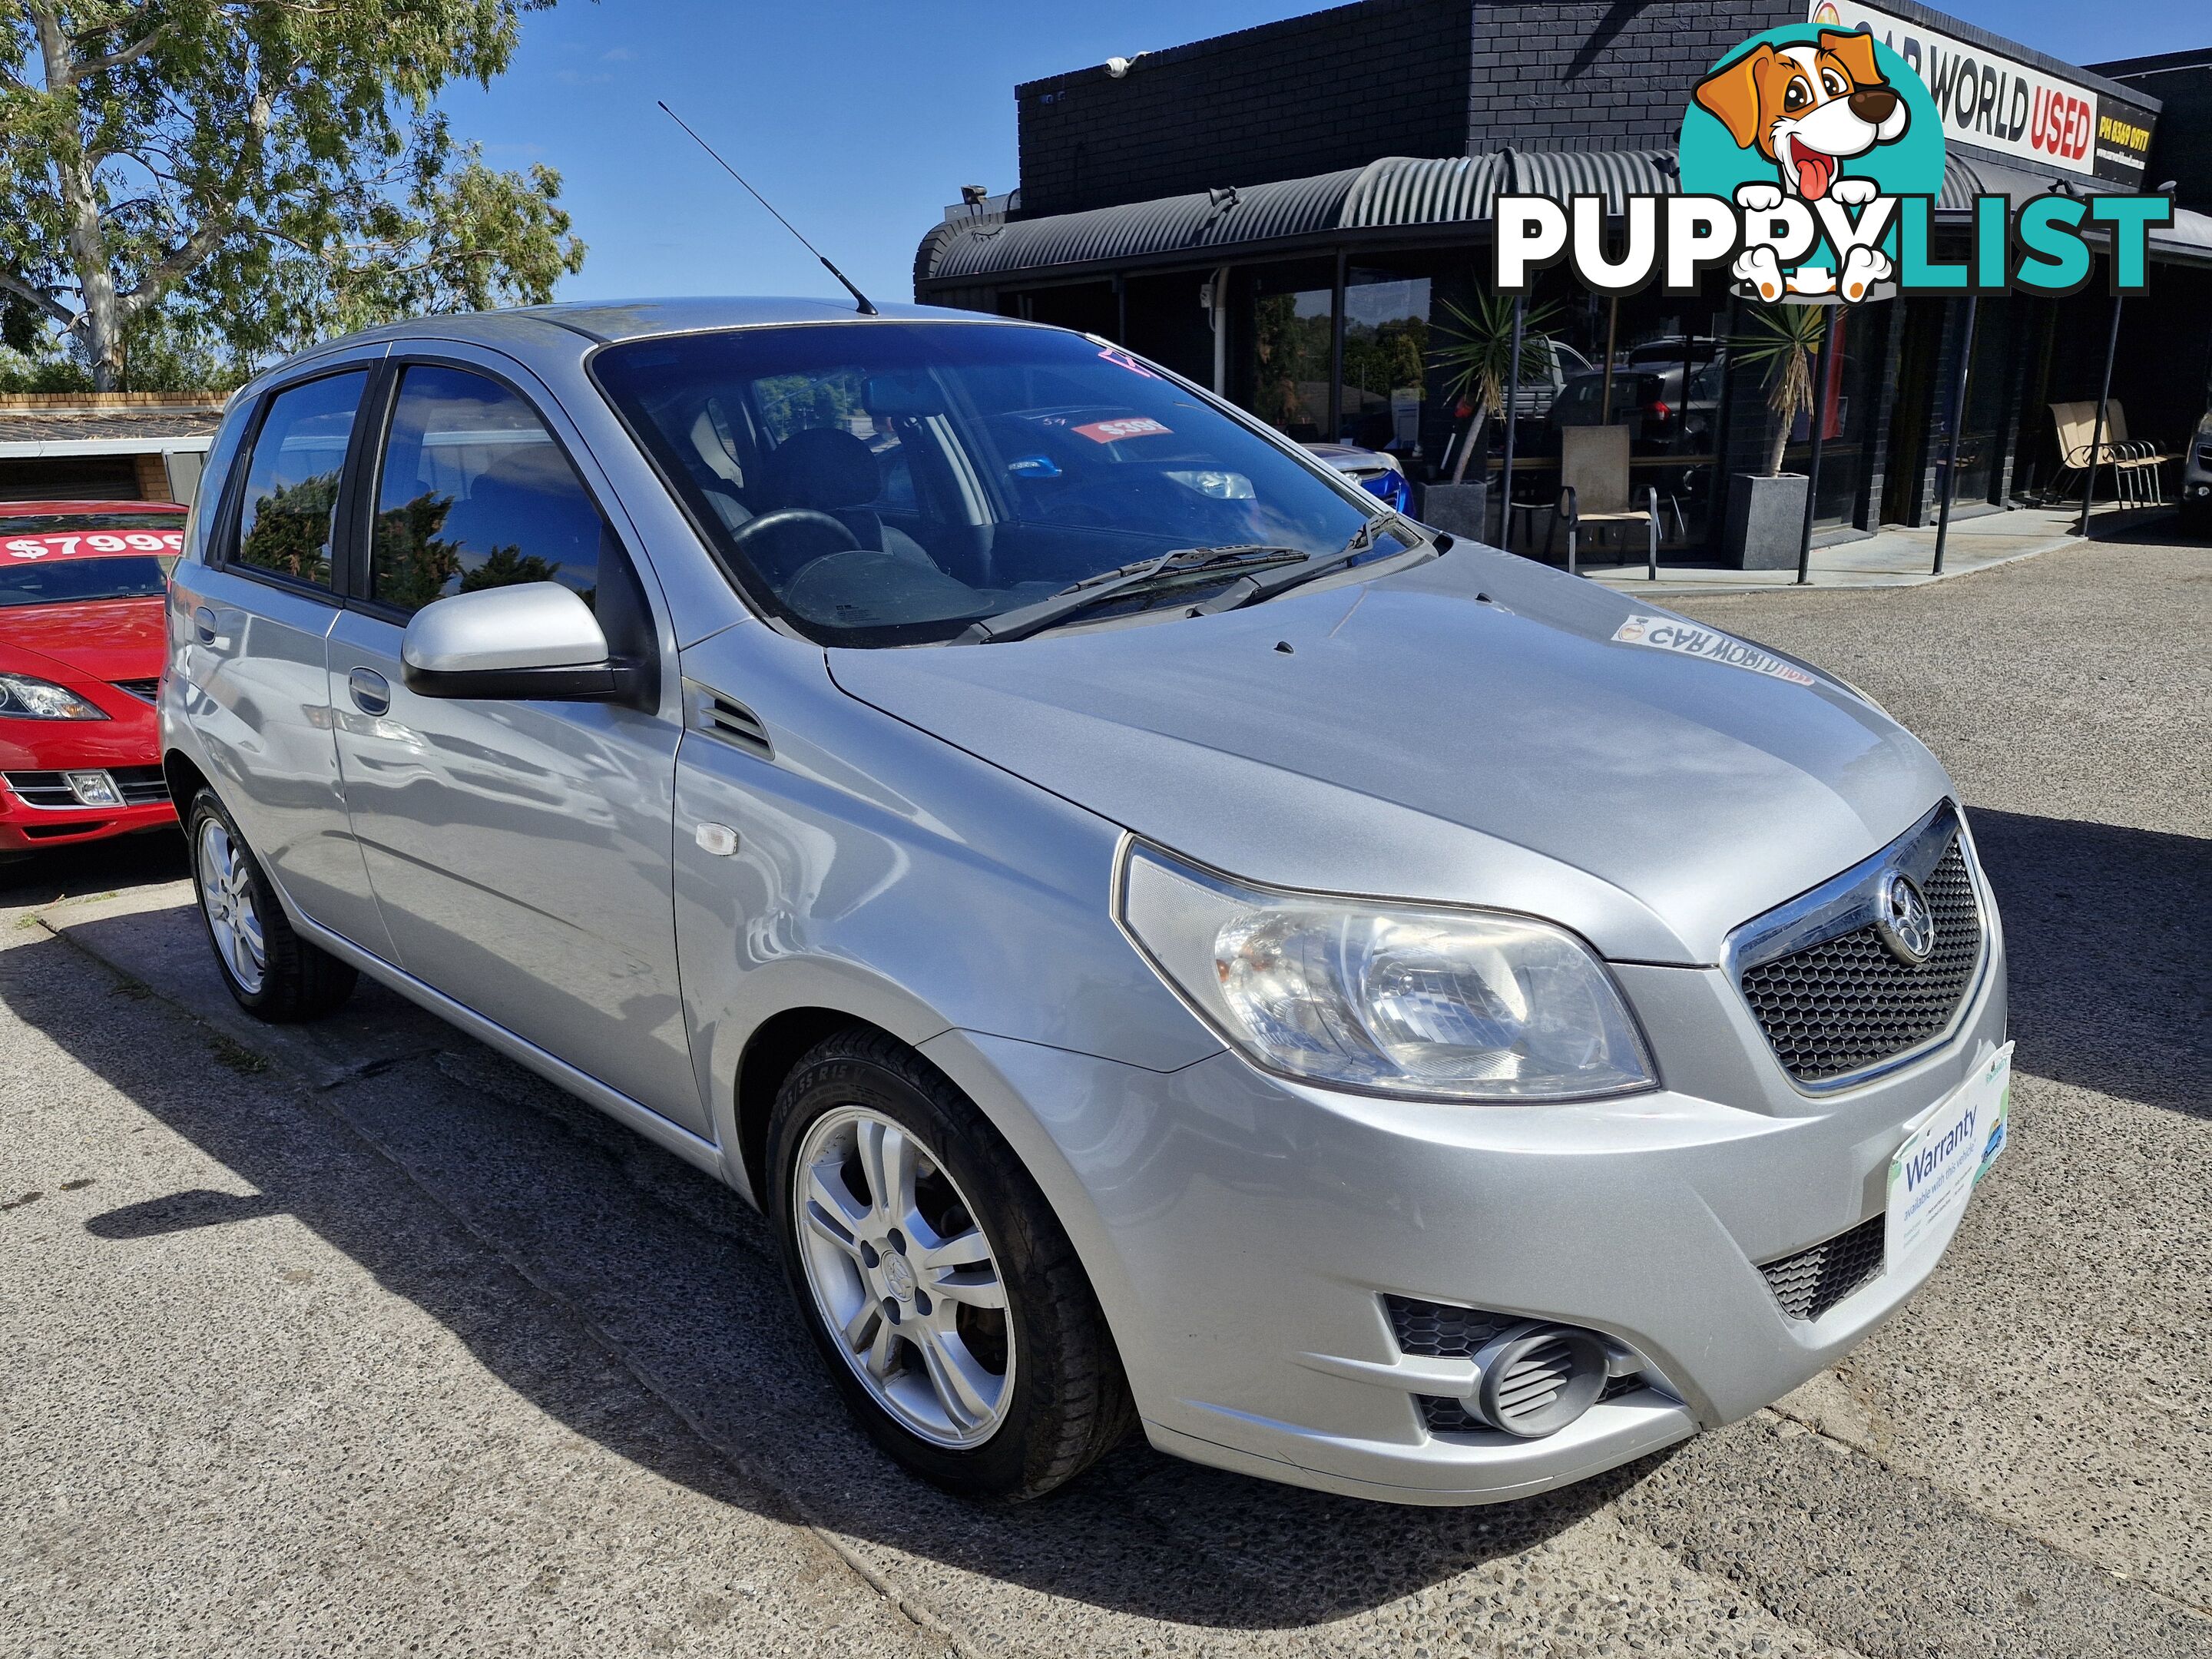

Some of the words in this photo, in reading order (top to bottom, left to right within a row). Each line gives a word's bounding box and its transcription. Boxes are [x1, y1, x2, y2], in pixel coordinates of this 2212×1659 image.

[1930, 45, 2029, 143] WORLD
[2031, 85, 2091, 161] USED
[2098, 115, 2113, 141] PH
[2111, 120, 2131, 147] 8369
[1906, 1104, 1978, 1193] Warranty
[1903, 1188, 1931, 1222] available
[1931, 1172, 1945, 1195] with
[1945, 1161, 1956, 1181] this
